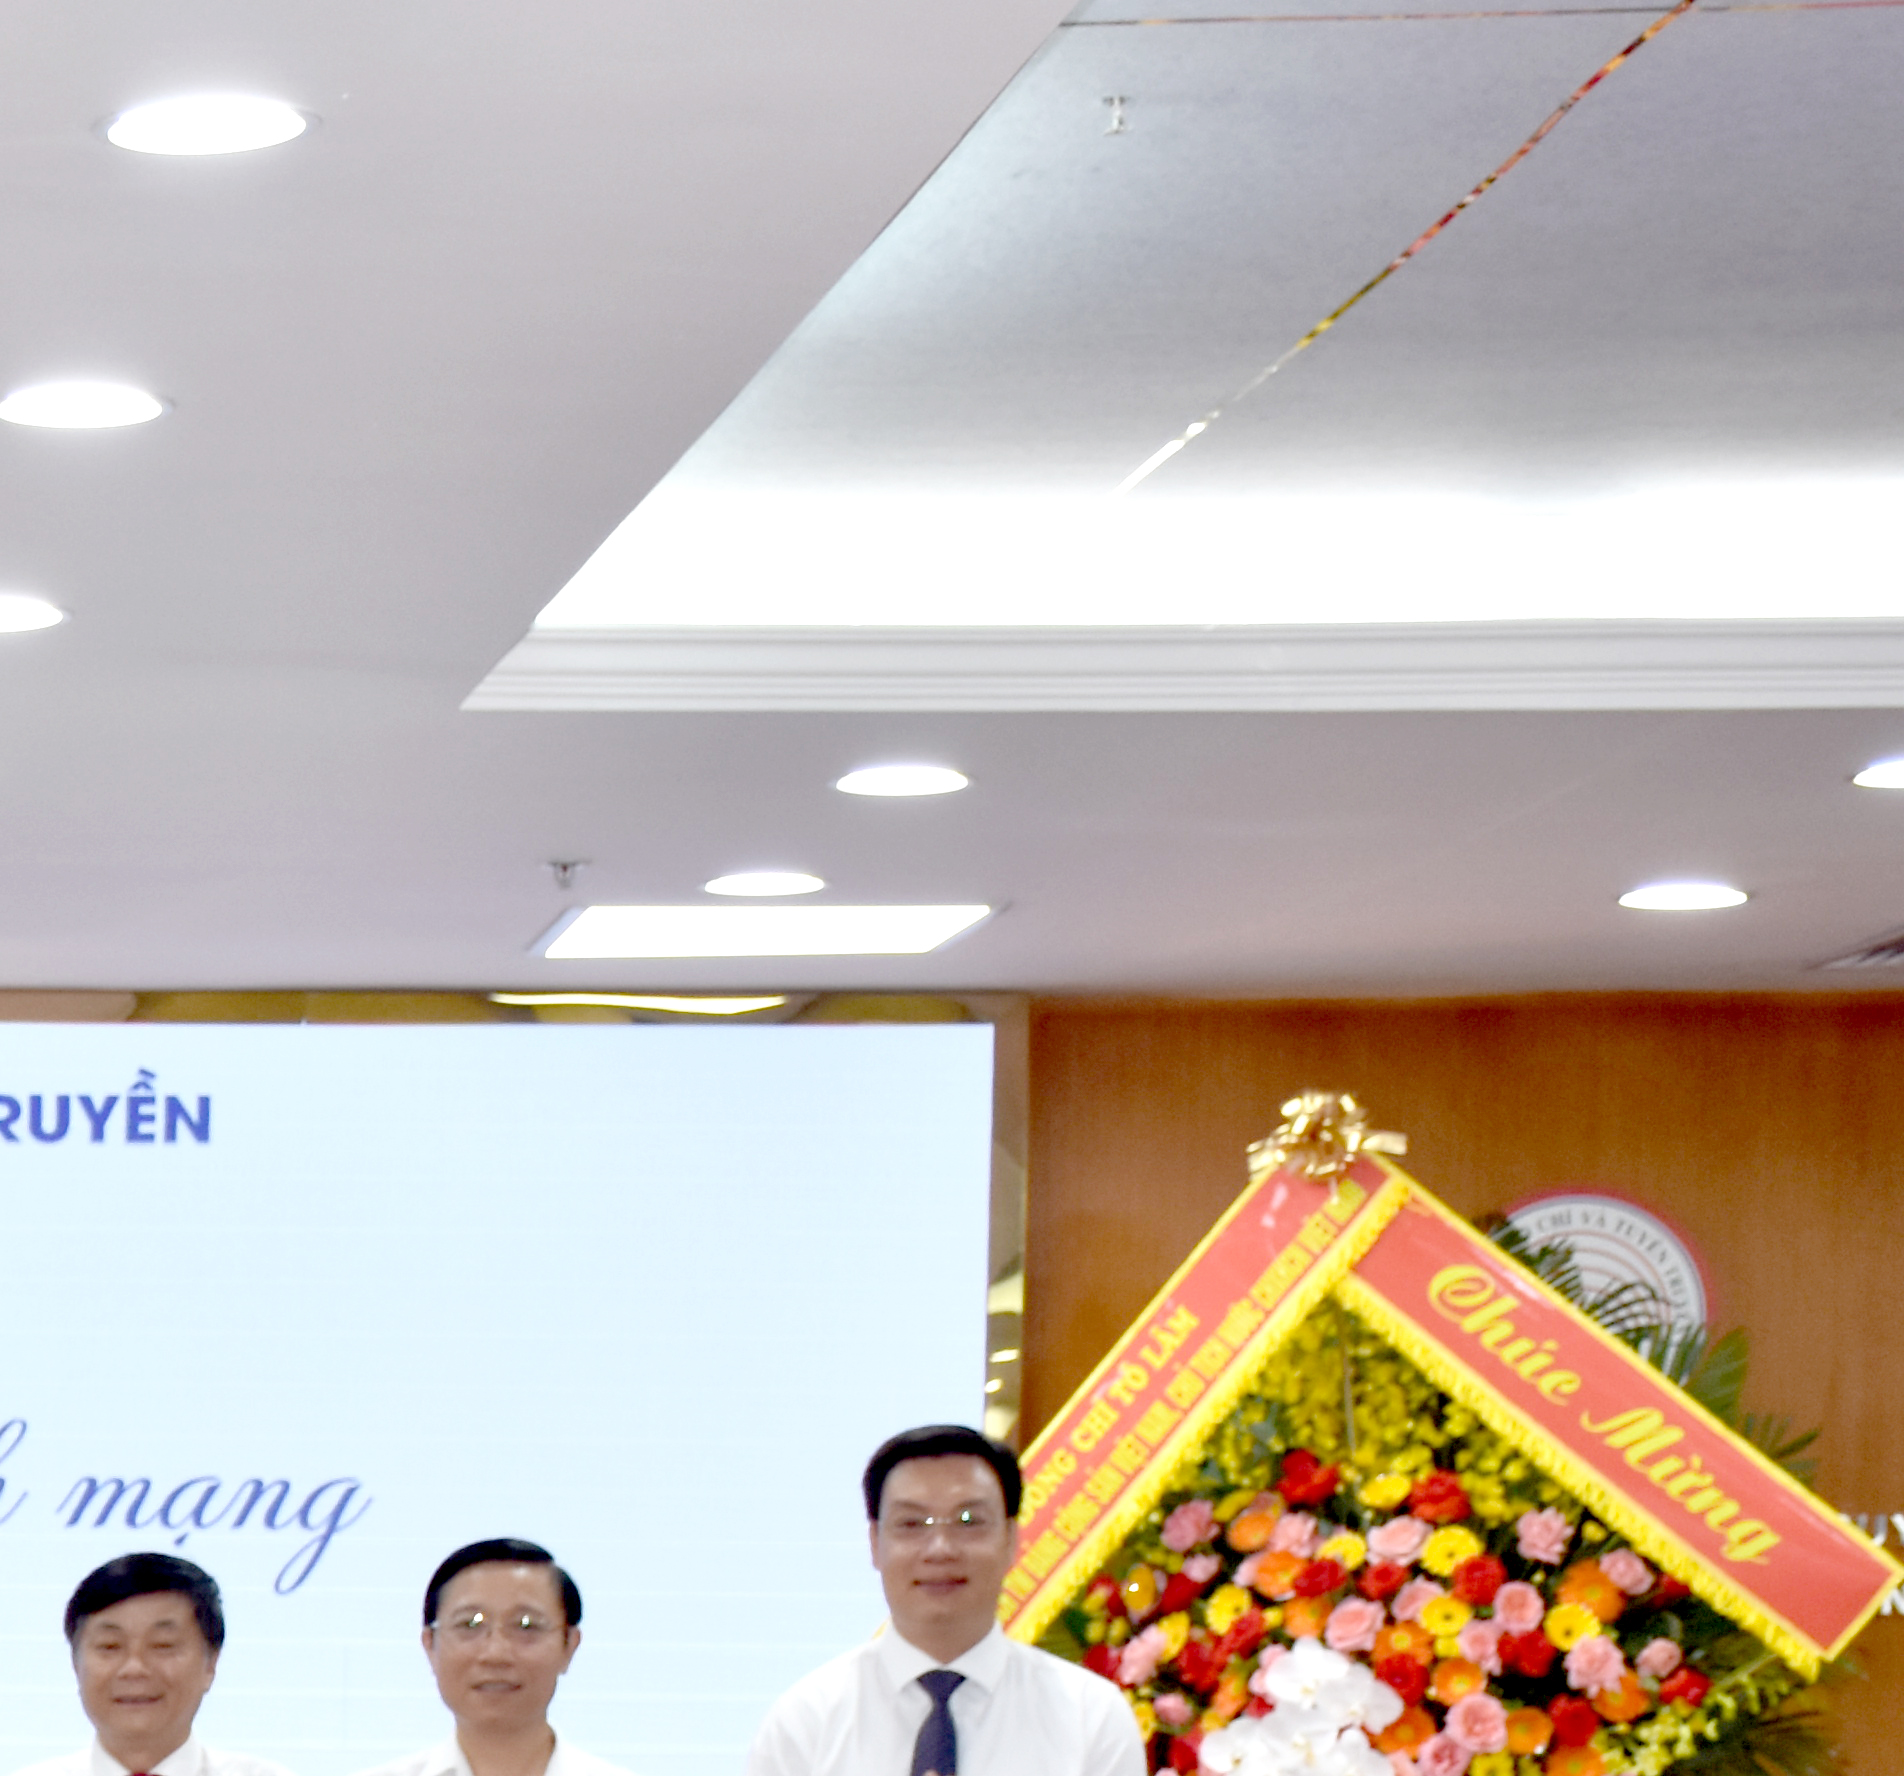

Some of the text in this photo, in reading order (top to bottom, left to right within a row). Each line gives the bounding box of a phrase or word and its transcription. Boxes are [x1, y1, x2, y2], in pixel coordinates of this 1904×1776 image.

[1427, 1264, 1782, 1566] Chúc Mừng
[55, 1474, 376, 1597] mạng
